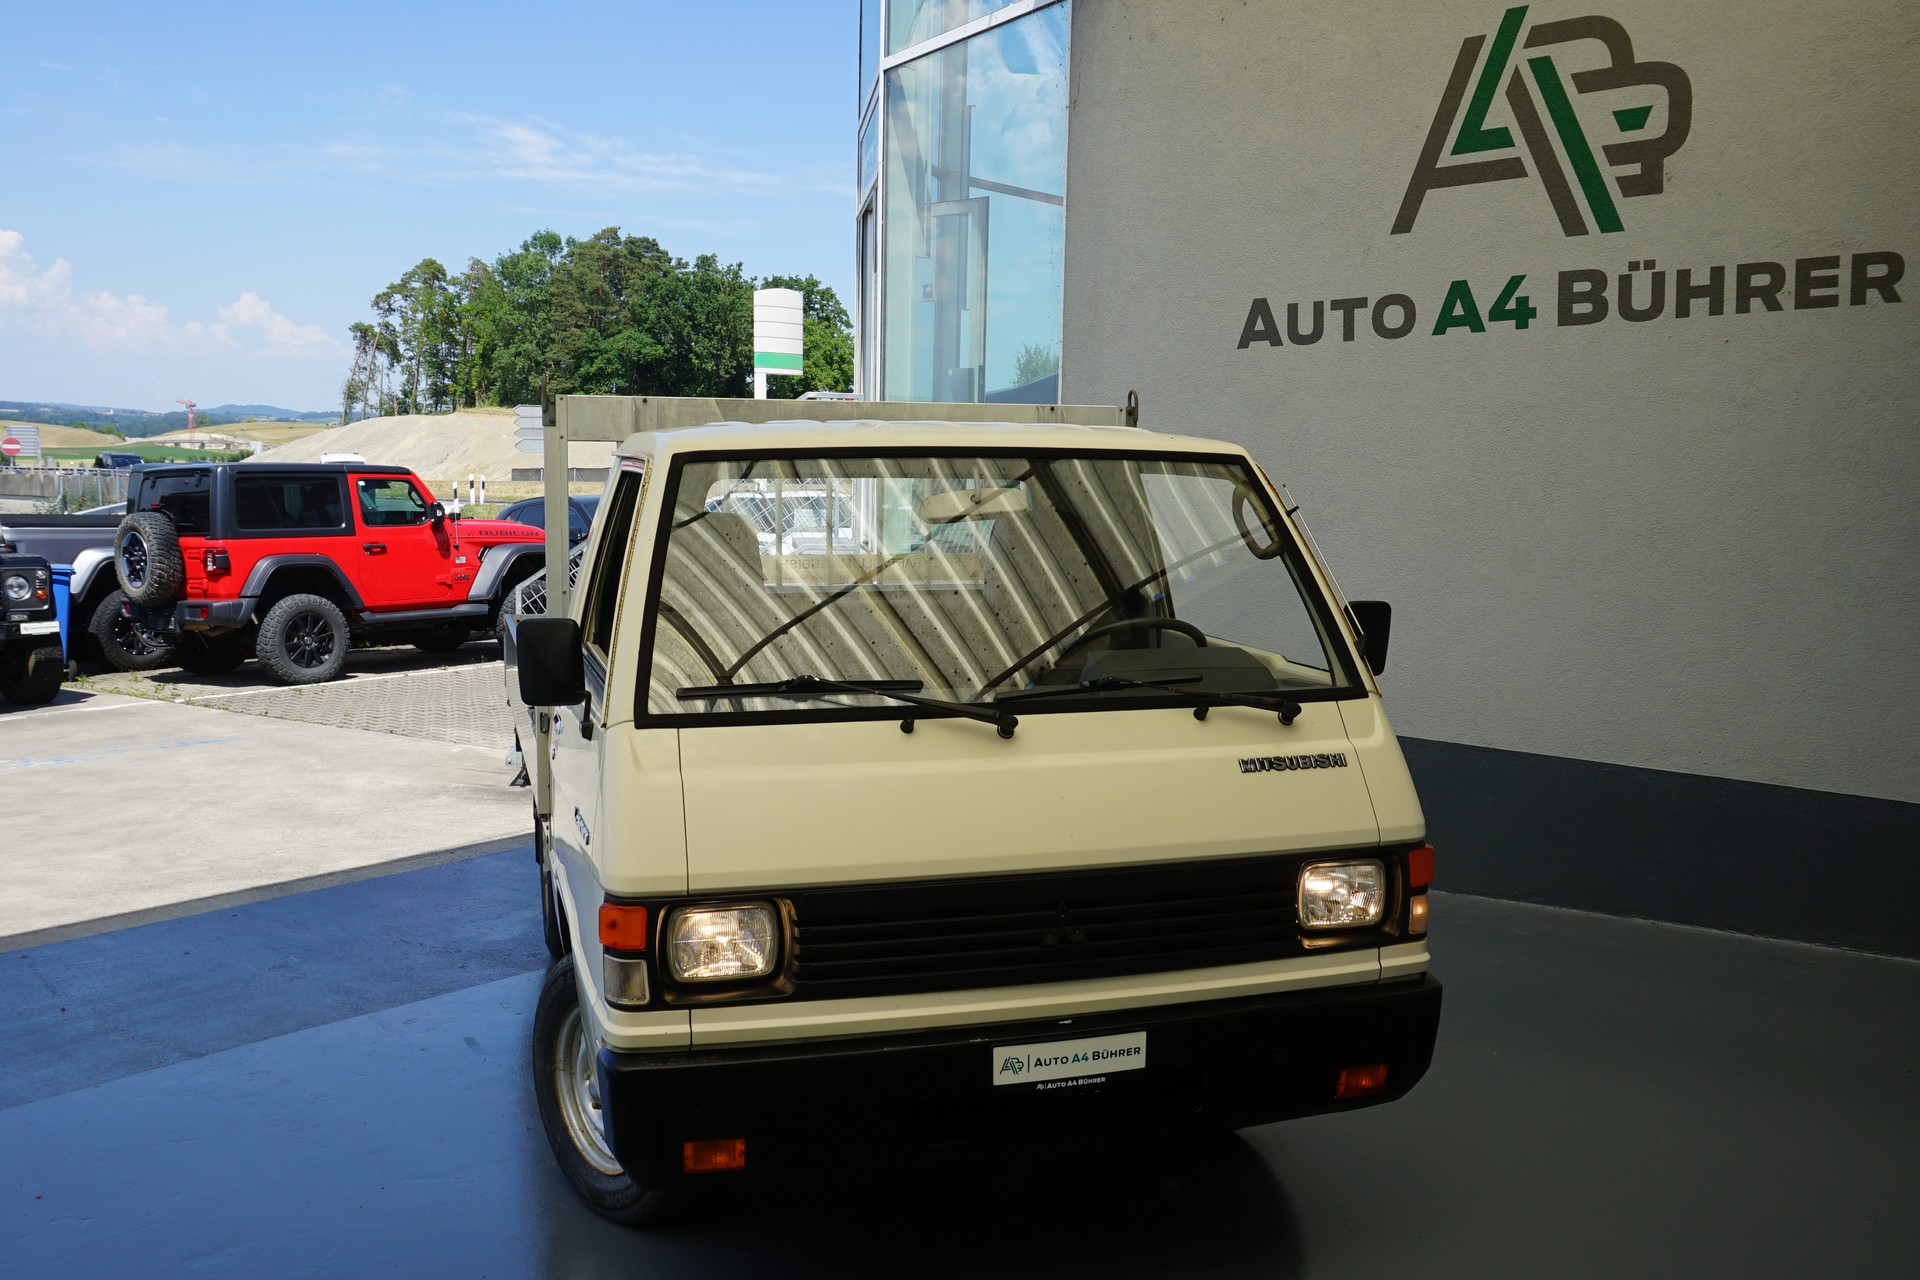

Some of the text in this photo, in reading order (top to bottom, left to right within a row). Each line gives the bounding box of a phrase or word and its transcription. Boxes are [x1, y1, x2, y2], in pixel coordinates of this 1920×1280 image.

[1236, 251, 1907, 350] AUTO A4 BÜHRER
[1238, 753, 1347, 773] MITSUBISHI
[1034, 1056, 1069, 1068] AUTO
[1071, 1052, 1089, 1063] A4
[1092, 1046, 1141, 1061] BÜHRER
